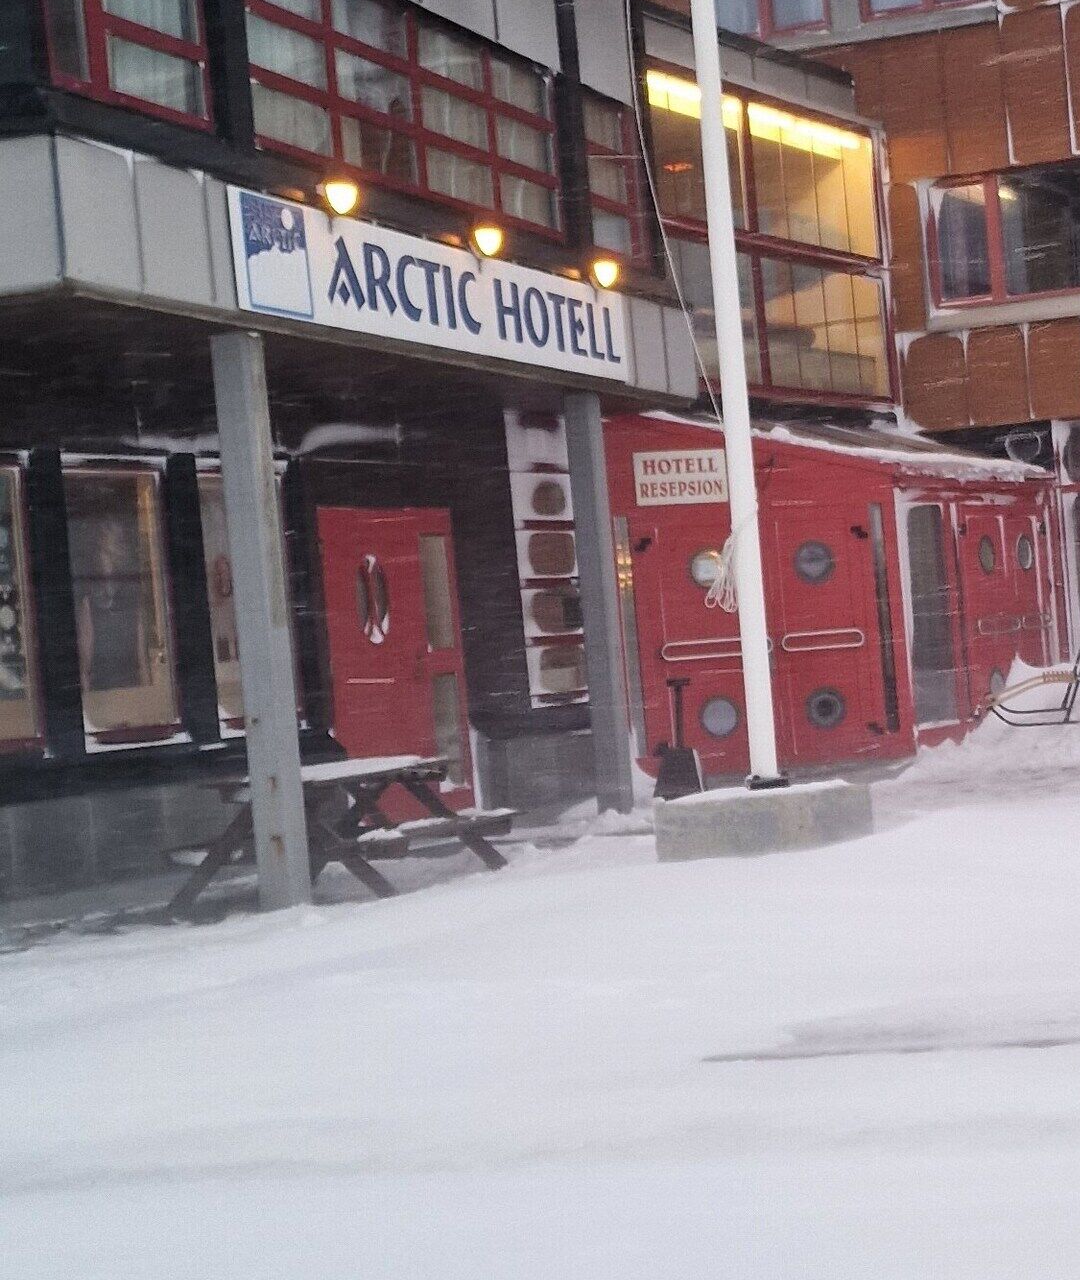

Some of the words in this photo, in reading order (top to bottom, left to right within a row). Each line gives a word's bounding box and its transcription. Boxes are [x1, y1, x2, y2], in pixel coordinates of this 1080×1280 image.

[327, 235, 482, 335] ARCTIC
[493, 277, 621, 363] HOTELL
[642, 457, 718, 475] HOTELL
[639, 479, 723, 498] RESEPSION
